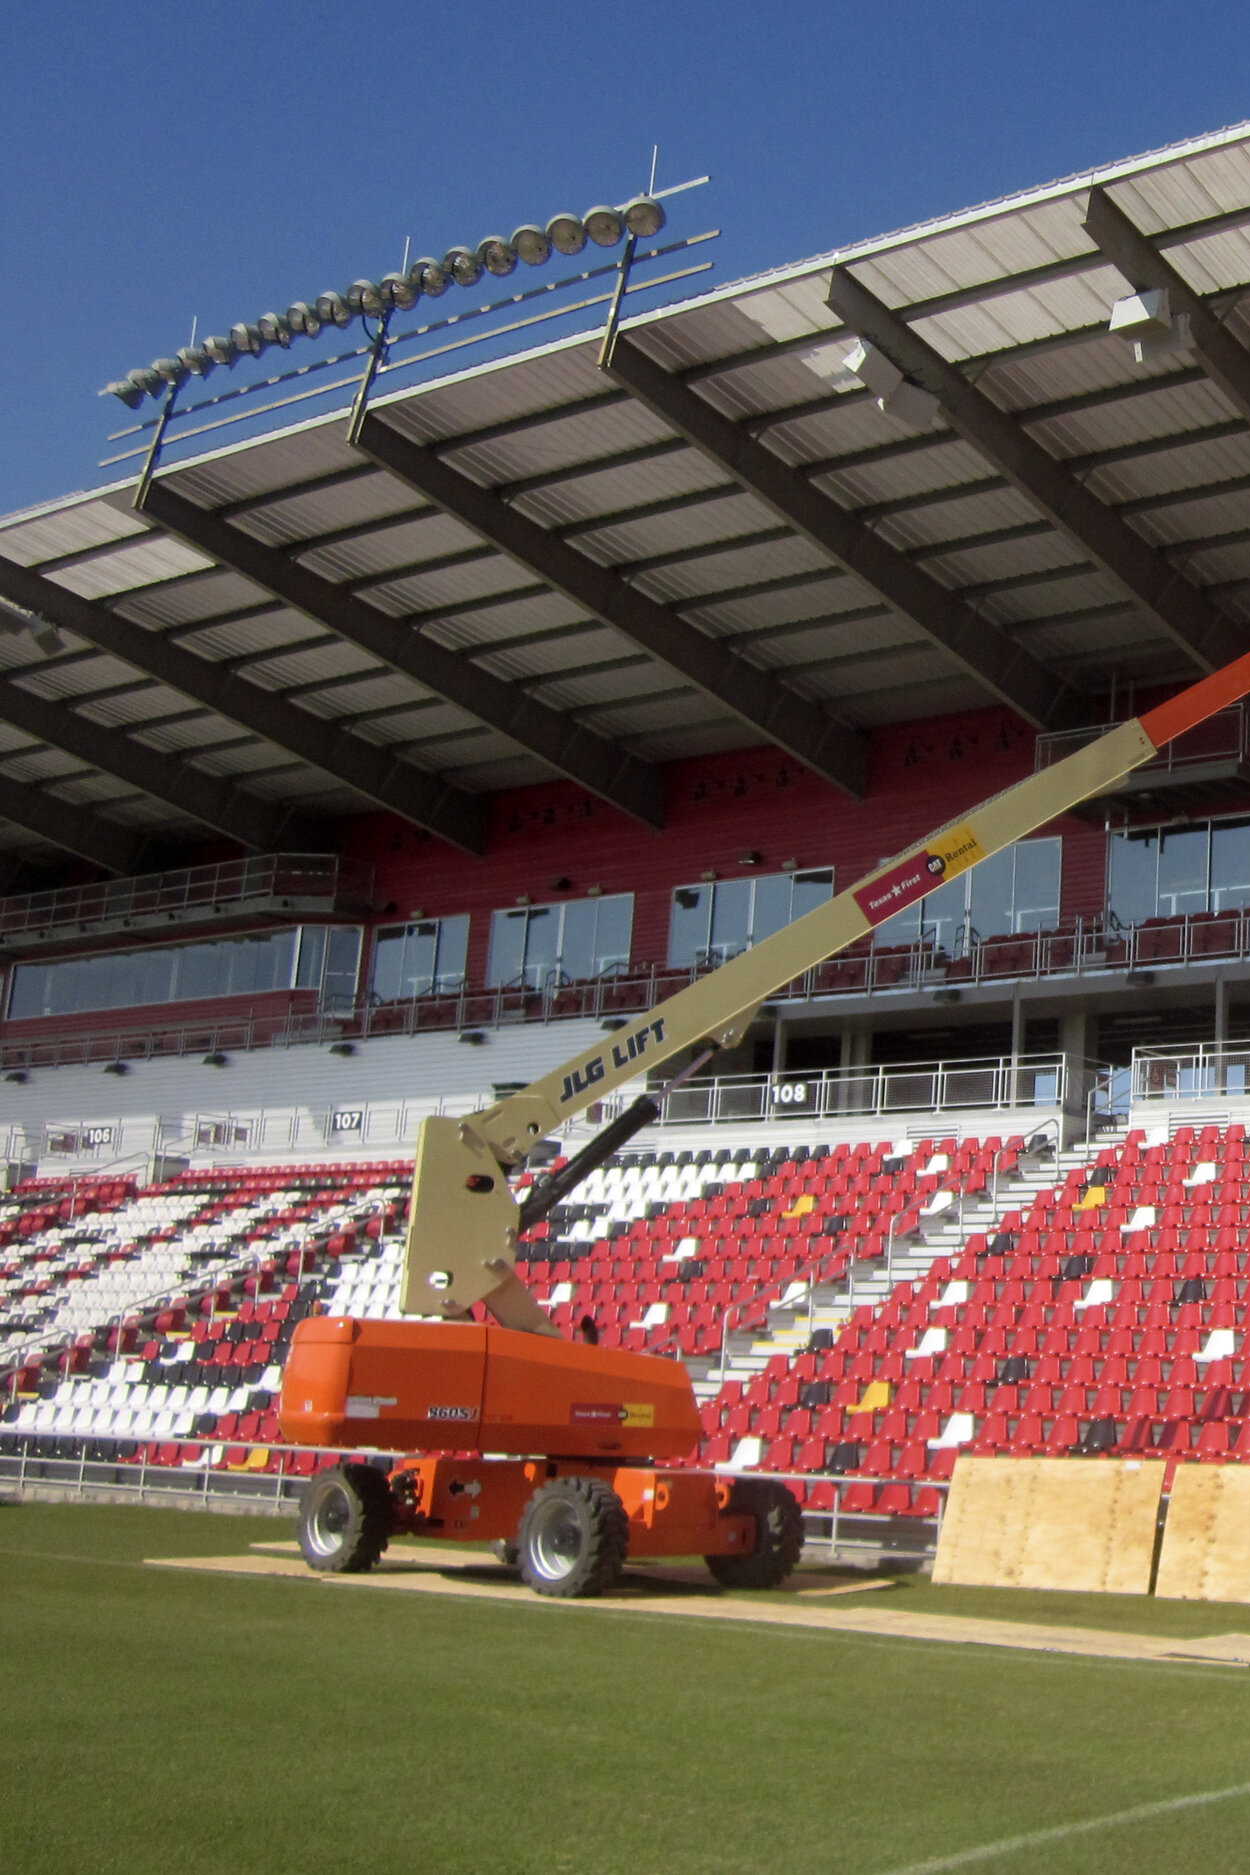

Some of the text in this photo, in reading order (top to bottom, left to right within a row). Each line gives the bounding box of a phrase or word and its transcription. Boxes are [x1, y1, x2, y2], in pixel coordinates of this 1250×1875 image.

[868, 838, 977, 910] Texas First CAT Rental
[560, 1018, 664, 1103] JLG LIFT
[772, 1084, 805, 1103] 108
[335, 1112, 360, 1129] 107
[89, 1128, 110, 1143] 106
